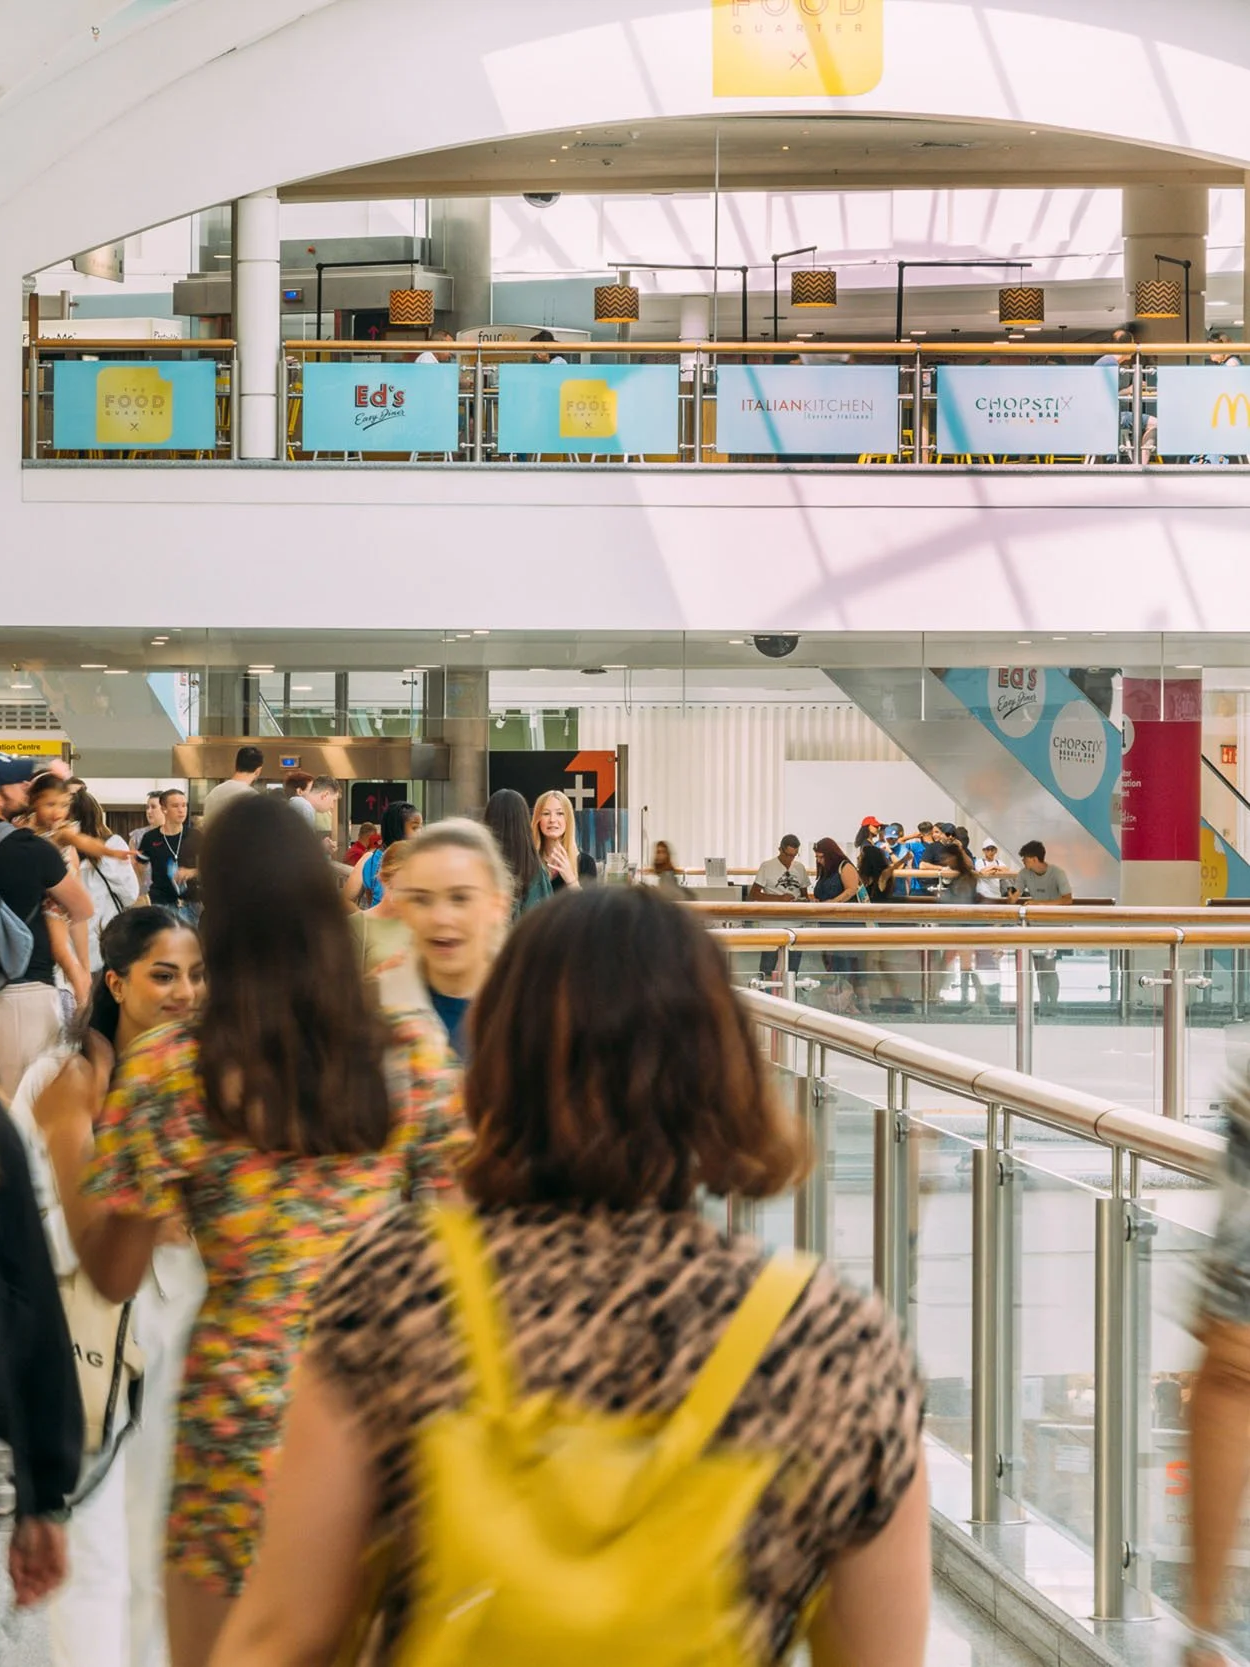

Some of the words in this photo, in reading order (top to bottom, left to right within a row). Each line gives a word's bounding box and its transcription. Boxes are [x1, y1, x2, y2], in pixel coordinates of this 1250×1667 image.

[732, 24, 863, 34] QUARTER
[104, 395, 166, 409] FOOD
[355, 384, 405, 408] Ed's
[975, 396, 1073, 410] CHOPSTIX
[1052, 736, 1103, 753] CHOPSTIX
